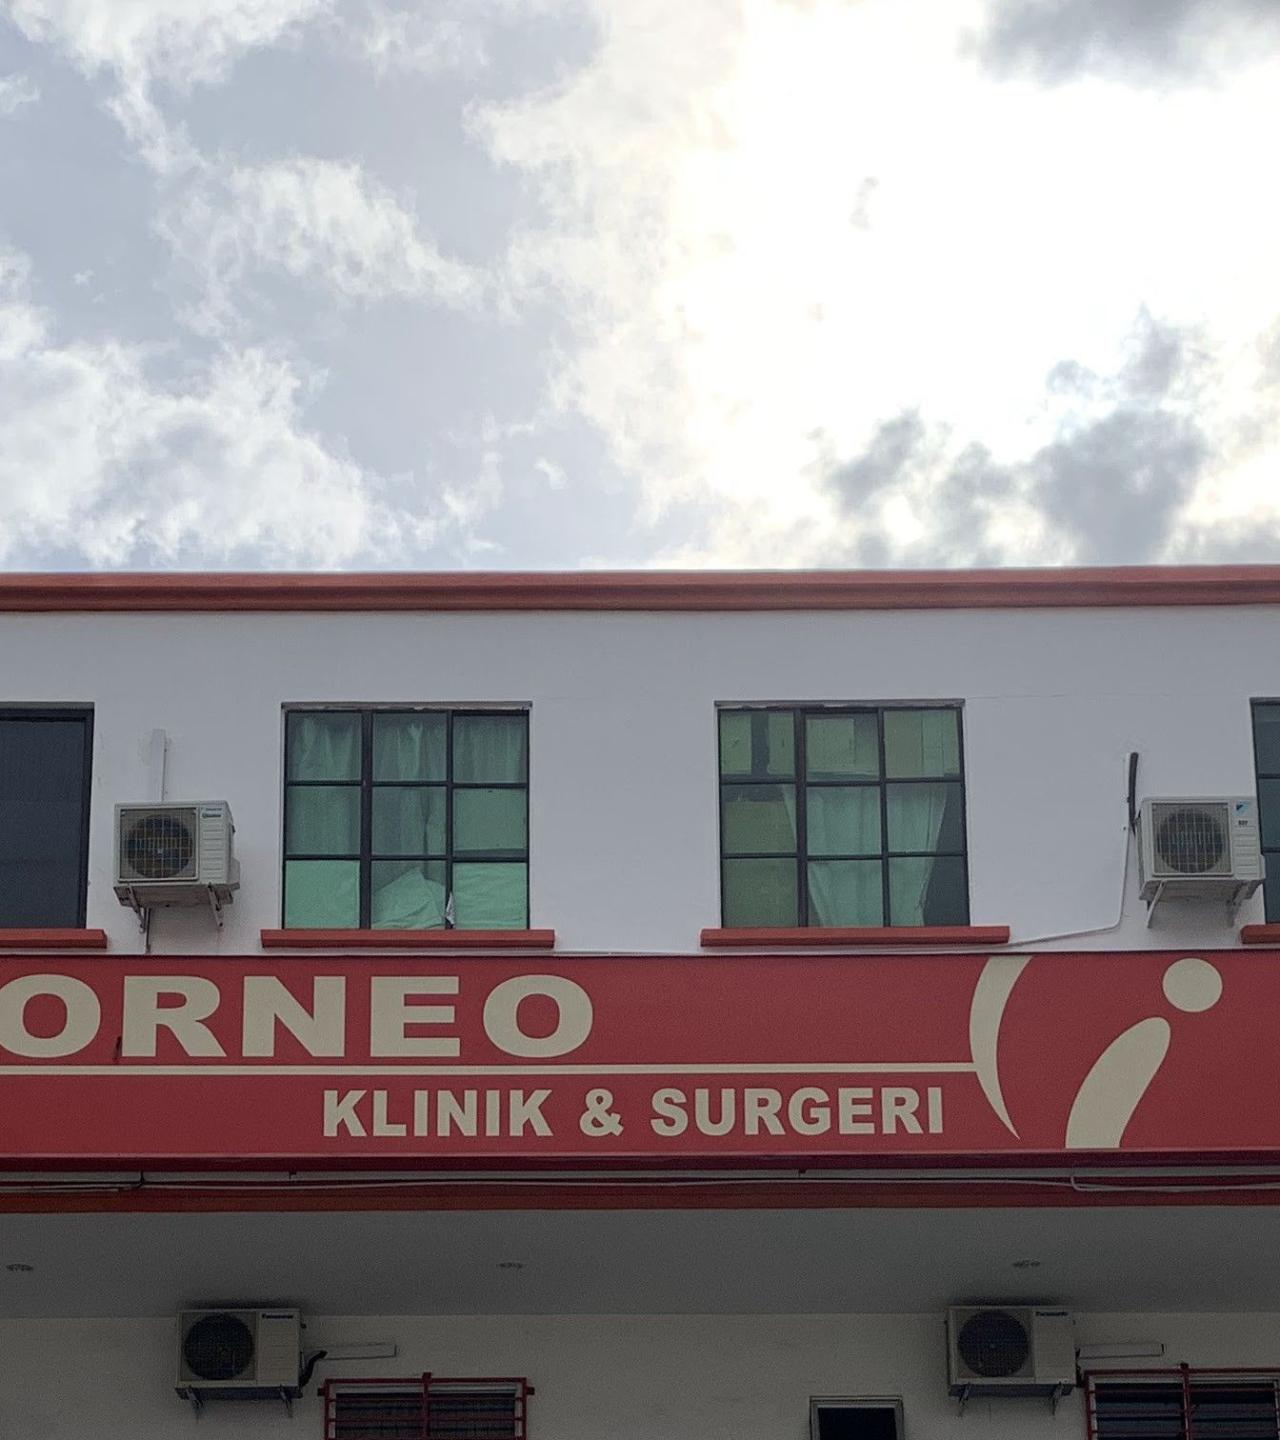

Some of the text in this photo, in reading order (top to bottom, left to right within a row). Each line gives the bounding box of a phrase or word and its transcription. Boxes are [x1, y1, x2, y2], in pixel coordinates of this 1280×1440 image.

[323, 1086, 944, 1138] KLINIK & SURGERI
